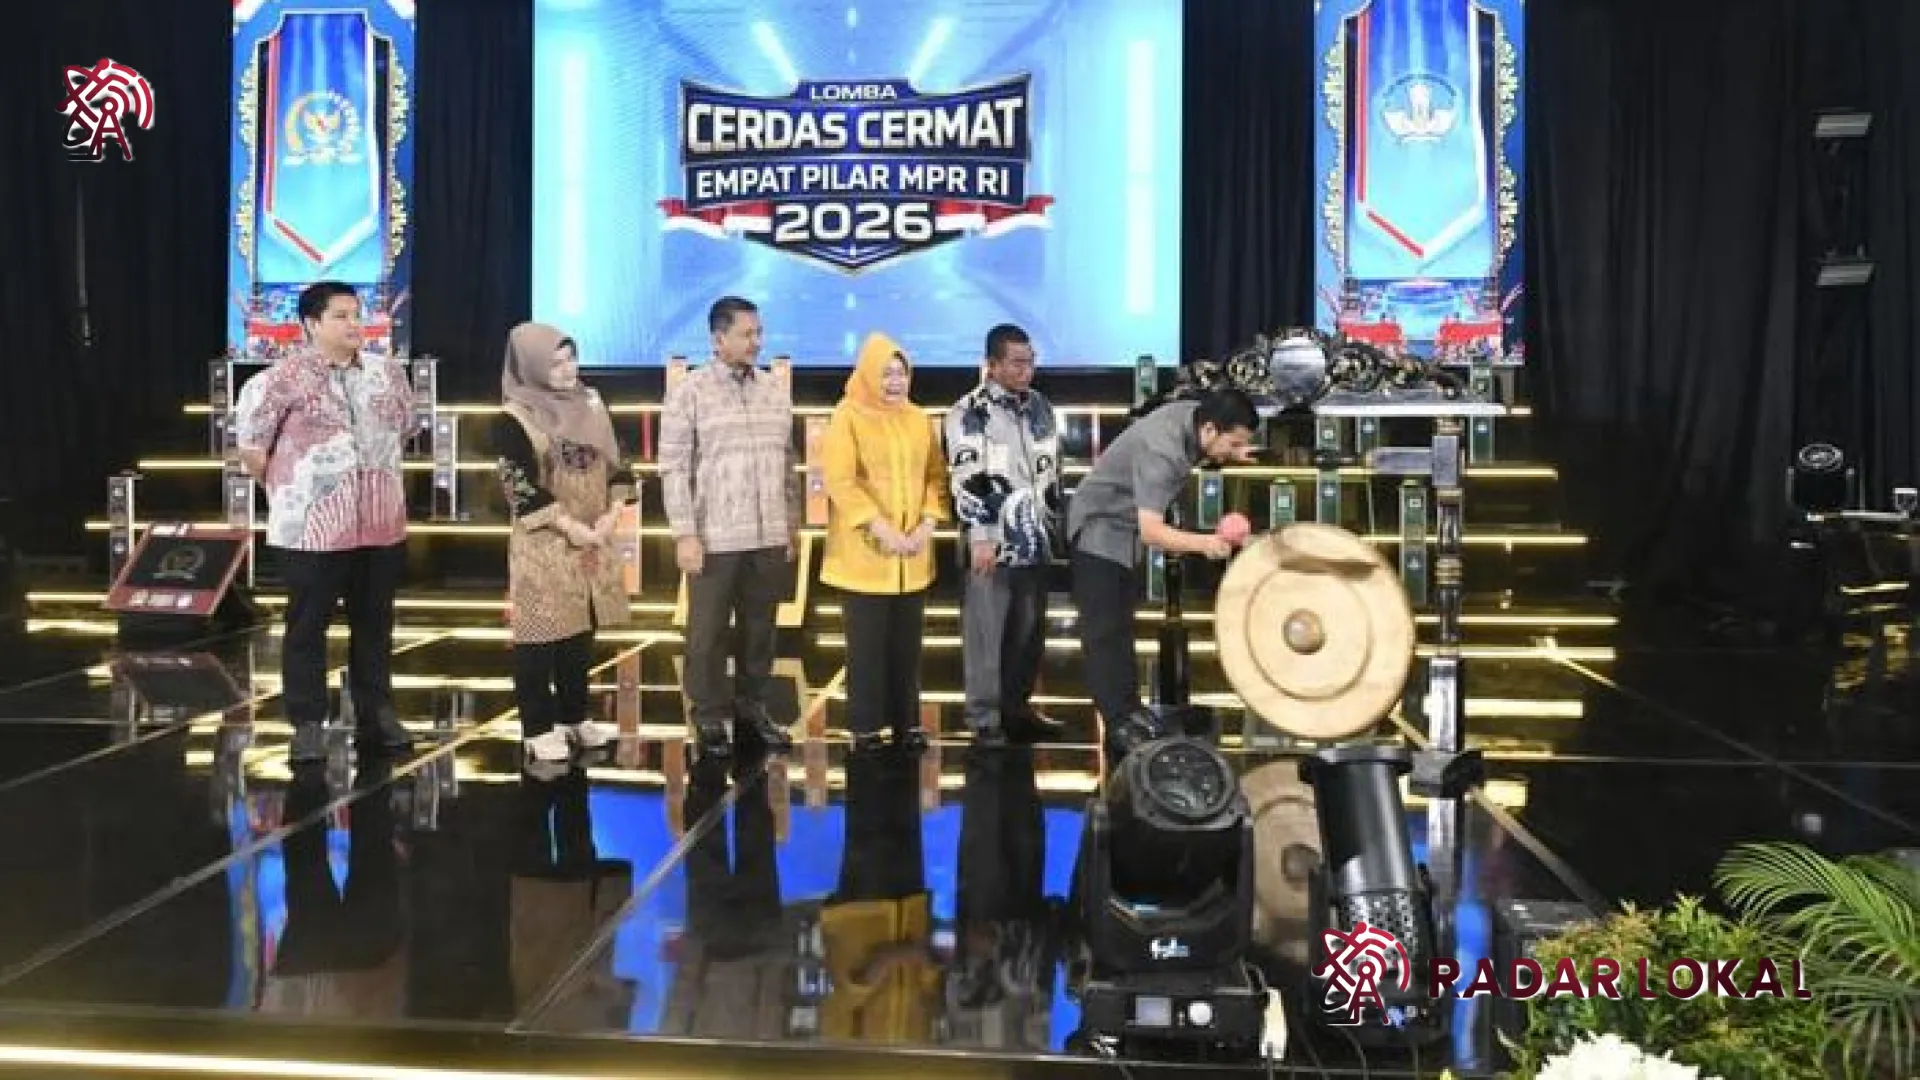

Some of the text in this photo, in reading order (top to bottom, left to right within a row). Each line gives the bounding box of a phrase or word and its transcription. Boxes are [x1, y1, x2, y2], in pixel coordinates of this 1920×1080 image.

[810, 84, 897, 100] LOMBA
[687, 97, 1024, 153] CERDAS CERMAT
[696, 163, 1010, 199] EMPAT PILAR MPR RI
[775, 202, 933, 242] 2026
